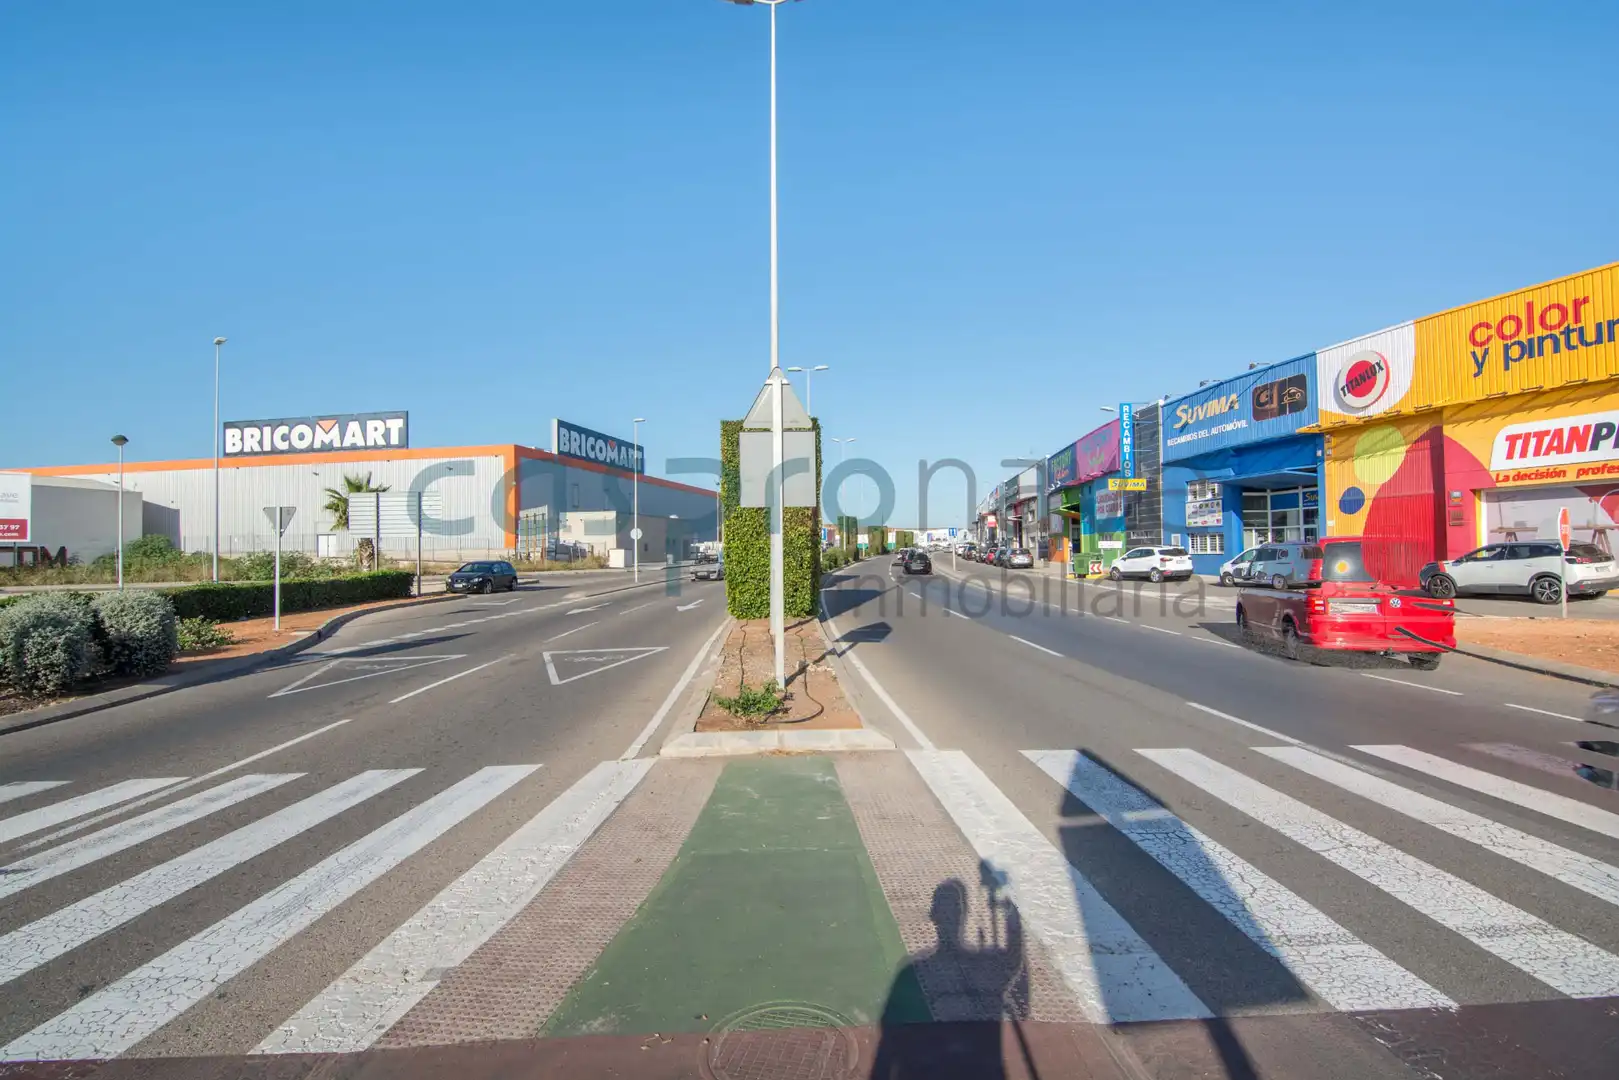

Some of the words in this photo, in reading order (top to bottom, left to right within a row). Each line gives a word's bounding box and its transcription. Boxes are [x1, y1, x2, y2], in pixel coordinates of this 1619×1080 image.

[1469, 295, 1590, 348] color
[1340, 359, 1384, 398] TITANLUX
[1470, 346, 1490, 378] y
[1173, 393, 1239, 429] SUVIMA
[225, 418, 404, 454] BRICOMART
[559, 426, 643, 471] BRICOMART
[1122, 405, 1131, 478] RECAMBIOS
[1167, 432, 1198, 447] RECAMBIOS
[1198, 429, 1209, 439] DEL
[1210, 419, 1249, 436] AUTOMÓVIL
[1111, 480, 1145, 489] SUVIMA
[1495, 472, 1511, 484] La
[1512, 468, 1567, 482] decisión
